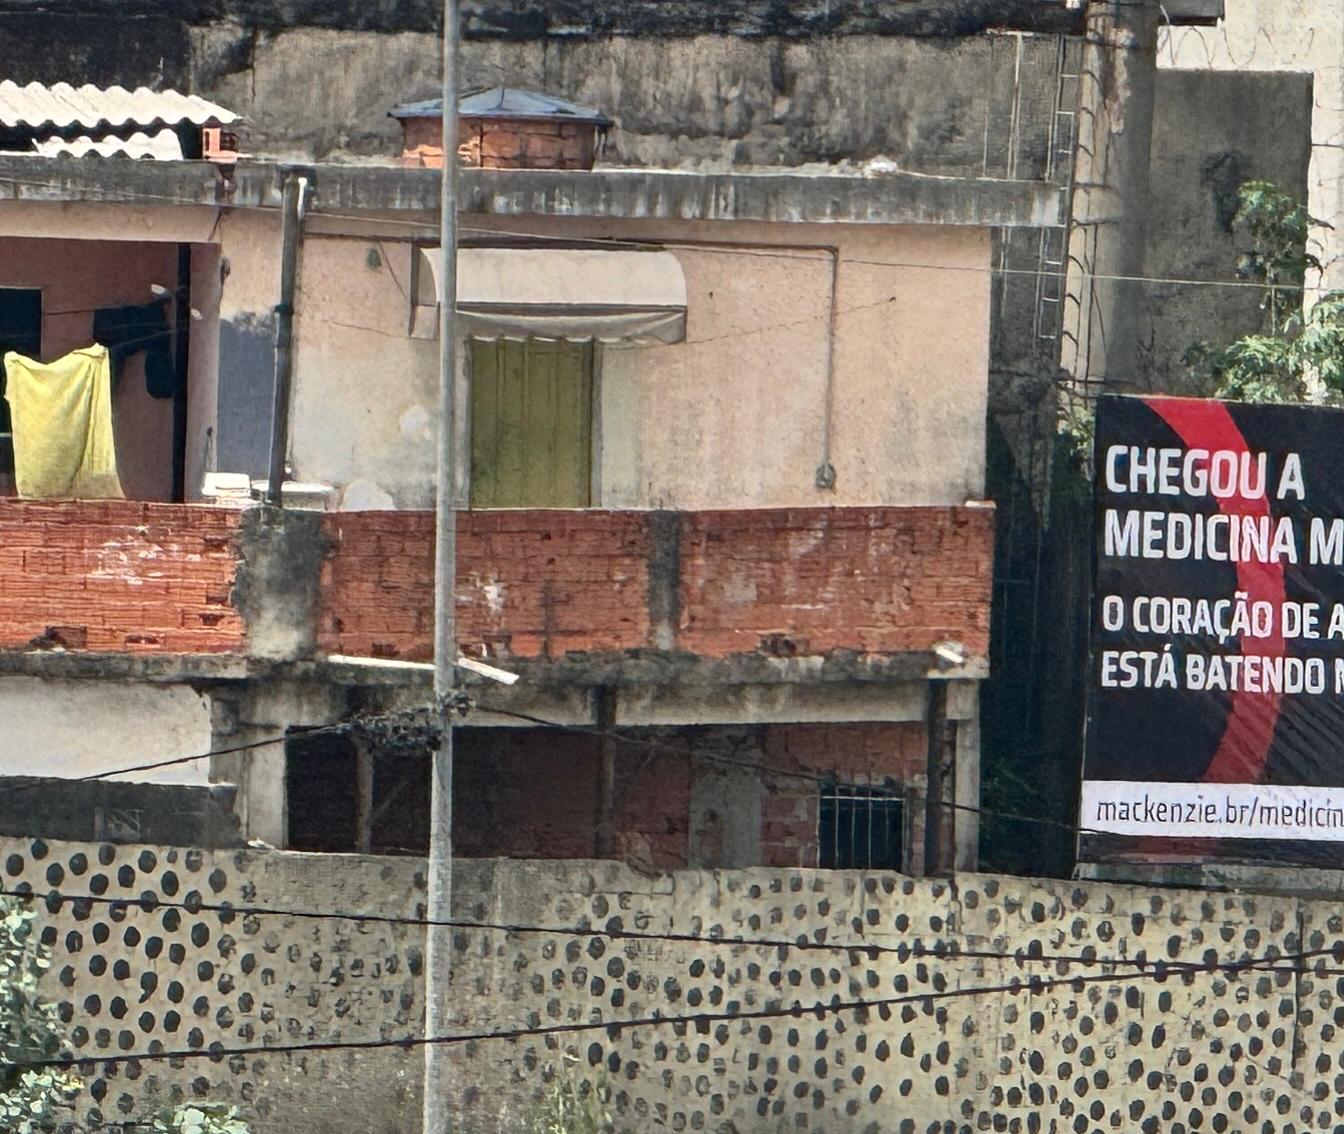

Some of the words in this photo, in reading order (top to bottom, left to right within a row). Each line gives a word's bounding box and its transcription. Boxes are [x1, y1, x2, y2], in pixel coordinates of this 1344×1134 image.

[1105, 444, 1267, 500] CHEGOU
[1276, 452, 1305, 501] A
[1104, 508, 1298, 565] MEDICINA
[1102, 595, 1125, 632] O
[1132, 590, 1273, 645] CORAÇÃO
[1281, 601, 1320, 640] DE
[1101, 642, 1178, 690] ESTÁ
[1184, 653, 1325, 695] BATENDO
